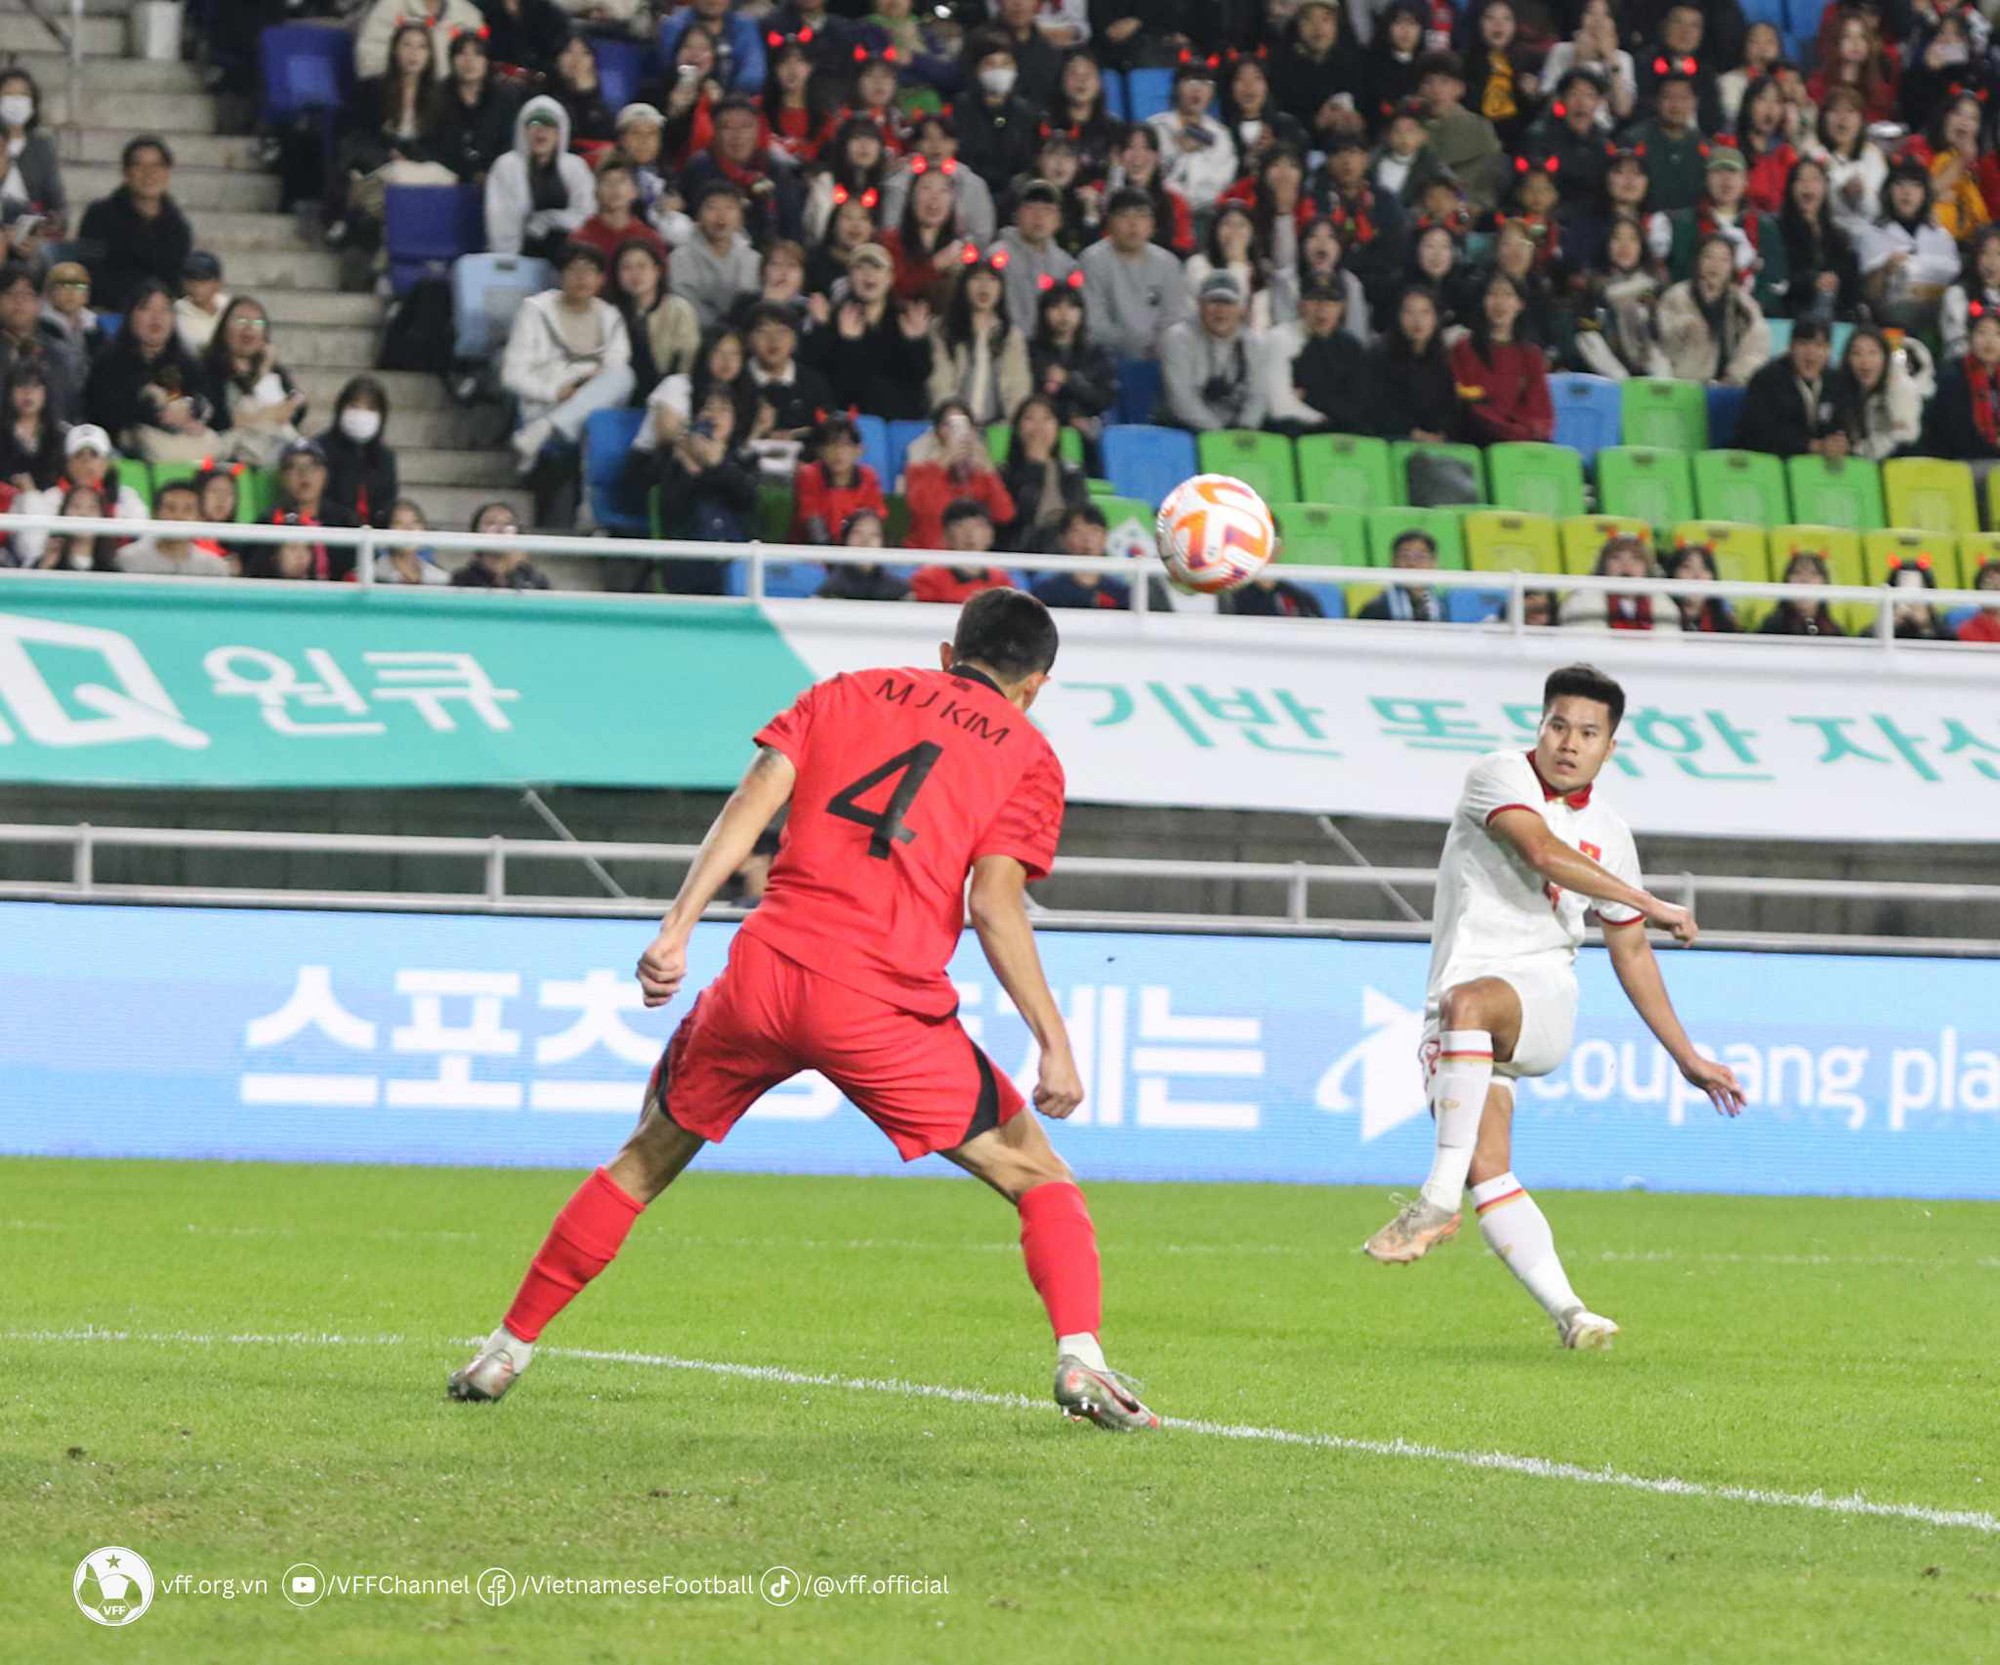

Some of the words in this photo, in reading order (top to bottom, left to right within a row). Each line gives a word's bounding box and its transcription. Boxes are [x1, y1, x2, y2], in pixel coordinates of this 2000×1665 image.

[203, 645, 520, 735] 원큐
[876, 678, 916, 705] M
[915, 691, 940, 708] J
[940, 701, 1011, 746] KIM
[1060, 680, 1346, 758] 기반
[825, 739, 943, 860] 4
[240, 965, 666, 1112] 스포츠
